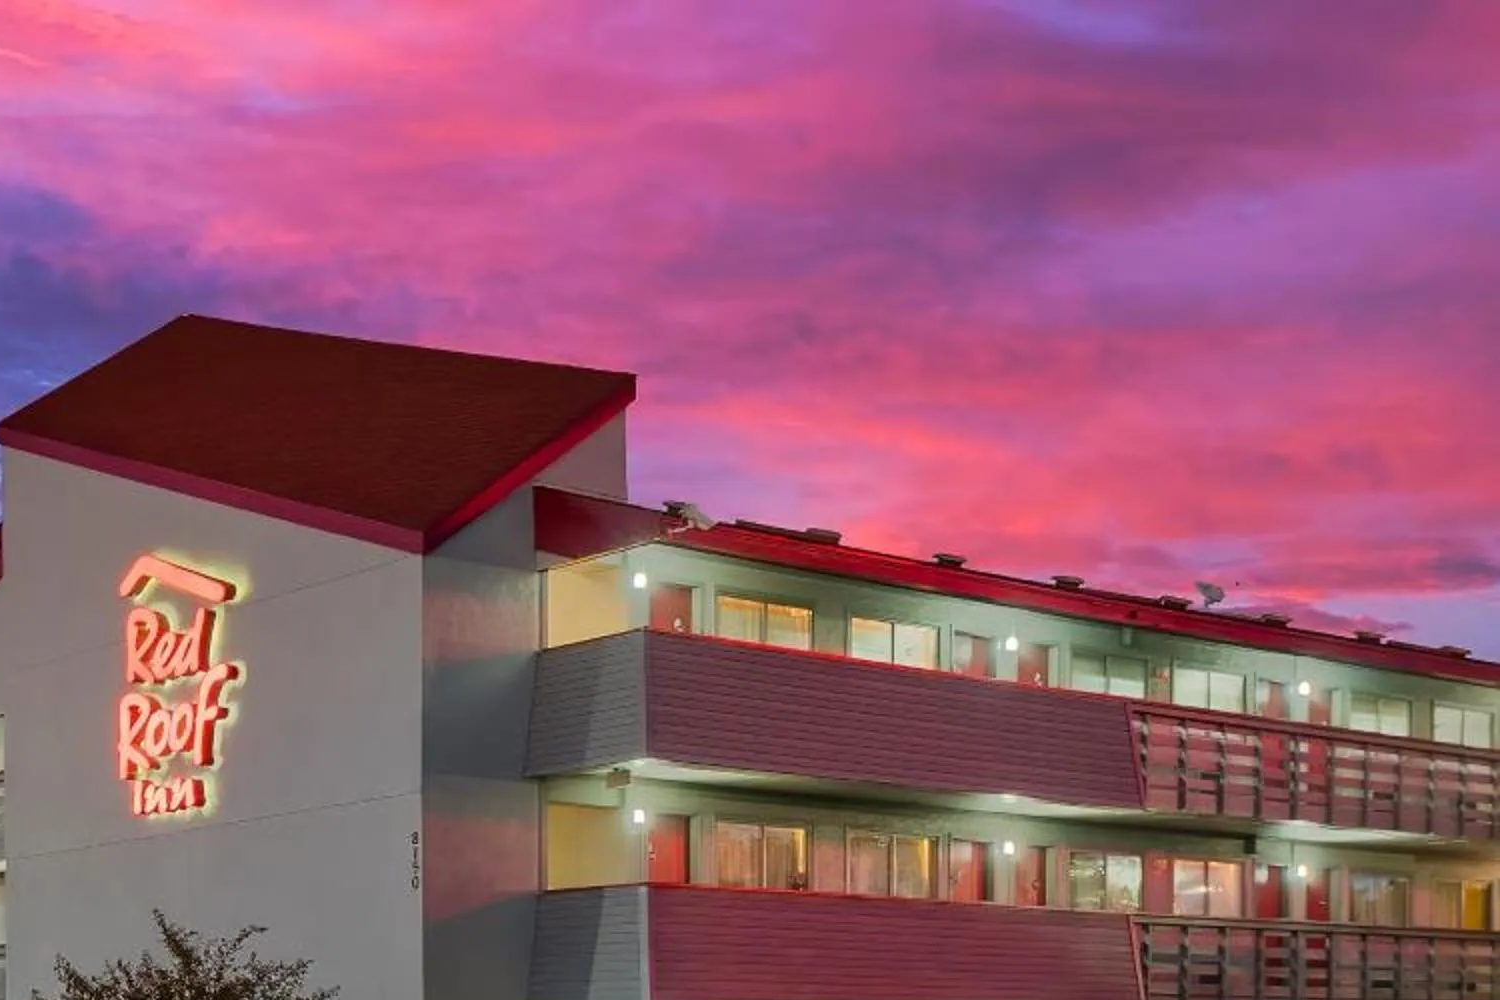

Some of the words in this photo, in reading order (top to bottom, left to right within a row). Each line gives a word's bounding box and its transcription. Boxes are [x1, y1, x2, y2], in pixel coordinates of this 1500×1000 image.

[127, 607, 216, 683] Red
[118, 663, 238, 780] Roof
[133, 777, 205, 816] Inn
